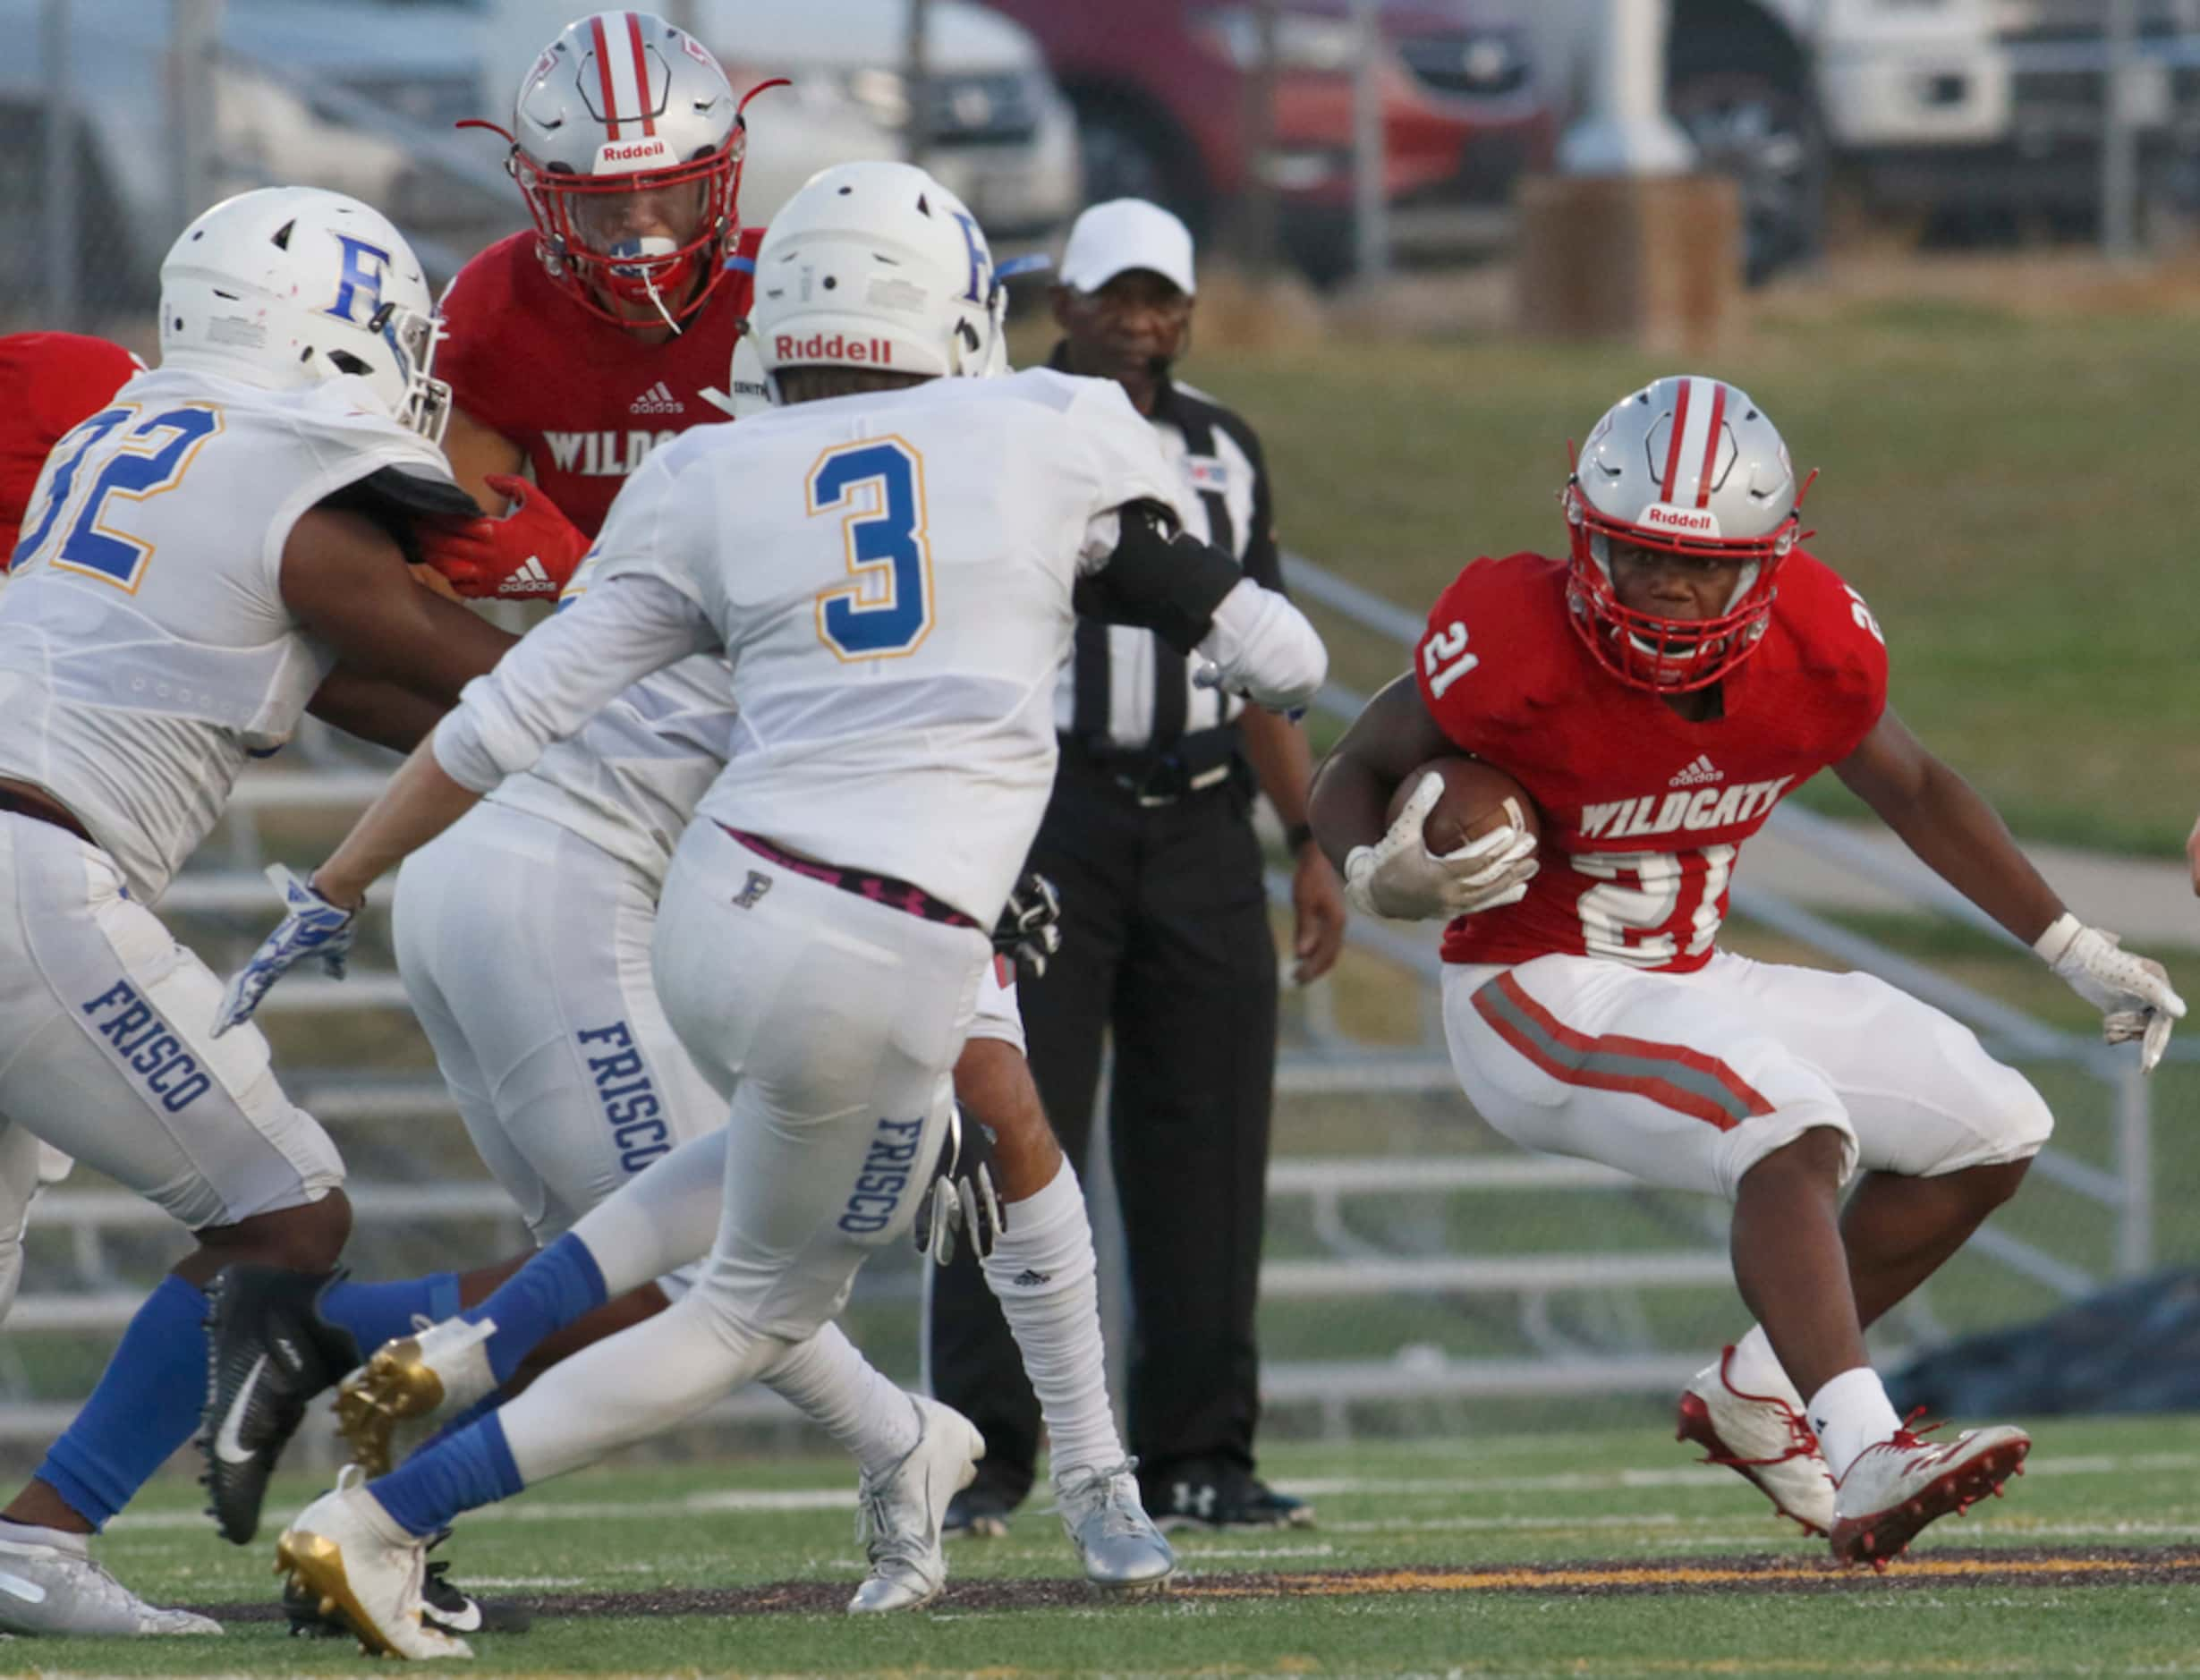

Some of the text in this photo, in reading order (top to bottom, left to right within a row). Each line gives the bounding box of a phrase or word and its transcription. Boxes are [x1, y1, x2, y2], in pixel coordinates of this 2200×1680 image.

[603, 142, 665, 161] Riddell
[775, 333, 892, 364] Riddell
[629, 402, 684, 414] adidas
[1649, 507, 1712, 530] Riddell
[805, 434, 935, 663] 3
[497, 580, 557, 593] adidas
[1423, 620, 1479, 700] 21
[1668, 770, 1725, 788] adidas
[1570, 844, 1737, 967] 21
[82, 979, 211, 1113] FRISCO
[577, 1021, 673, 1174] FRISCO
[837, 1116, 924, 1234] FRISCO
